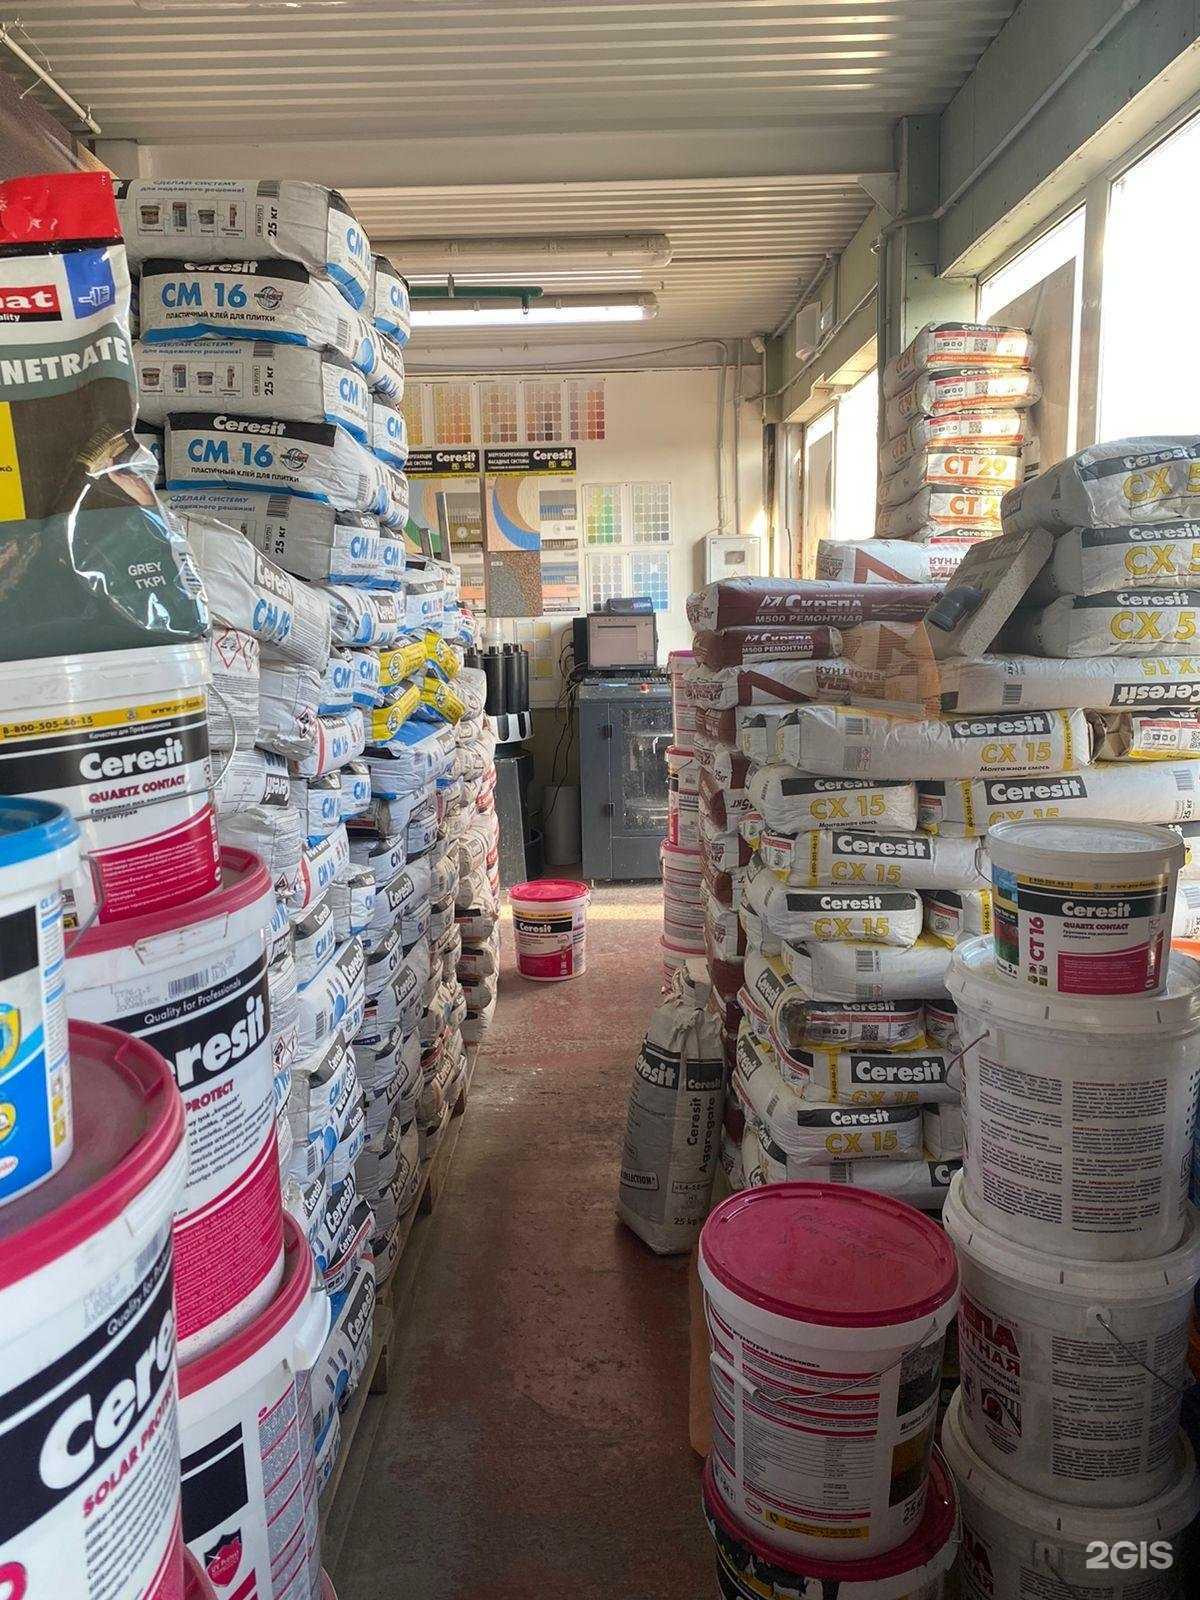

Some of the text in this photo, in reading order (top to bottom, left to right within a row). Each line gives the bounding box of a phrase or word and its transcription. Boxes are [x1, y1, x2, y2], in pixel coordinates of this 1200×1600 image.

[268, 221, 278, 238] 25
[0, 290, 53, 308] at
[162, 282, 202, 308] CM
[215, 283, 247, 309] 16
[0, 336, 130, 386] NETRATE
[265, 382, 274, 397] 25
[213, 416, 288, 436] Ceresit
[188, 439, 274, 468] CM 16
[436, 452, 476, 463] Ceresit
[533, 450, 573, 461] Ceresit
[944, 456, 1008, 476] CT 29
[1122, 466, 1172, 502] CX
[950, 496, 980, 515] CT
[1128, 523, 1200, 541] Ceresit
[275, 539, 285, 554] 25
[128, 562, 162, 576] GREY
[1124, 544, 1176, 576] CX
[1116, 592, 1190, 606] Ceresit
[789, 615, 863, 623] РЕМОНТНАЯ
[1109, 611, 1196, 641] CX 5
[954, 716, 1046, 736] Ceresit
[79, 738, 184, 780] Ceresit
[981, 742, 1051, 764] CX 15
[88, 783, 140, 804] QUARTZ
[142, 774, 185, 792] CONTACT
[814, 779, 877, 791] Ceresit
[990, 779, 1081, 802] Ceresit
[809, 795, 887, 820] CX 15
[837, 836, 926, 857] Ceresit
[831, 861, 901, 884] CX 15
[820, 896, 882, 910] Ceresit
[1061, 901, 1131, 918] Ceresit
[519, 922, 552, 933] Ceresit
[813, 917, 889, 938] CX 15
[1062, 921, 1130, 931] QUARTZ CONTACT
[1029, 917, 1045, 962] CT 16
[144, 978, 242, 1025] Quality for Professionals
[168, 997, 265, 1084] resit
[856, 1060, 942, 1081] Ceresit
[686, 1097, 702, 1147] Ceresit
[830, 1109, 890, 1124] Ceresit
[825, 1130, 898, 1153] CX 15
[326, 1178, 355, 1233] Ceresit
[348, 1281, 376, 1343] Ceresit
[39, 1308, 173, 1490] Cere
[83, 1445, 140, 1519] SOLAR
